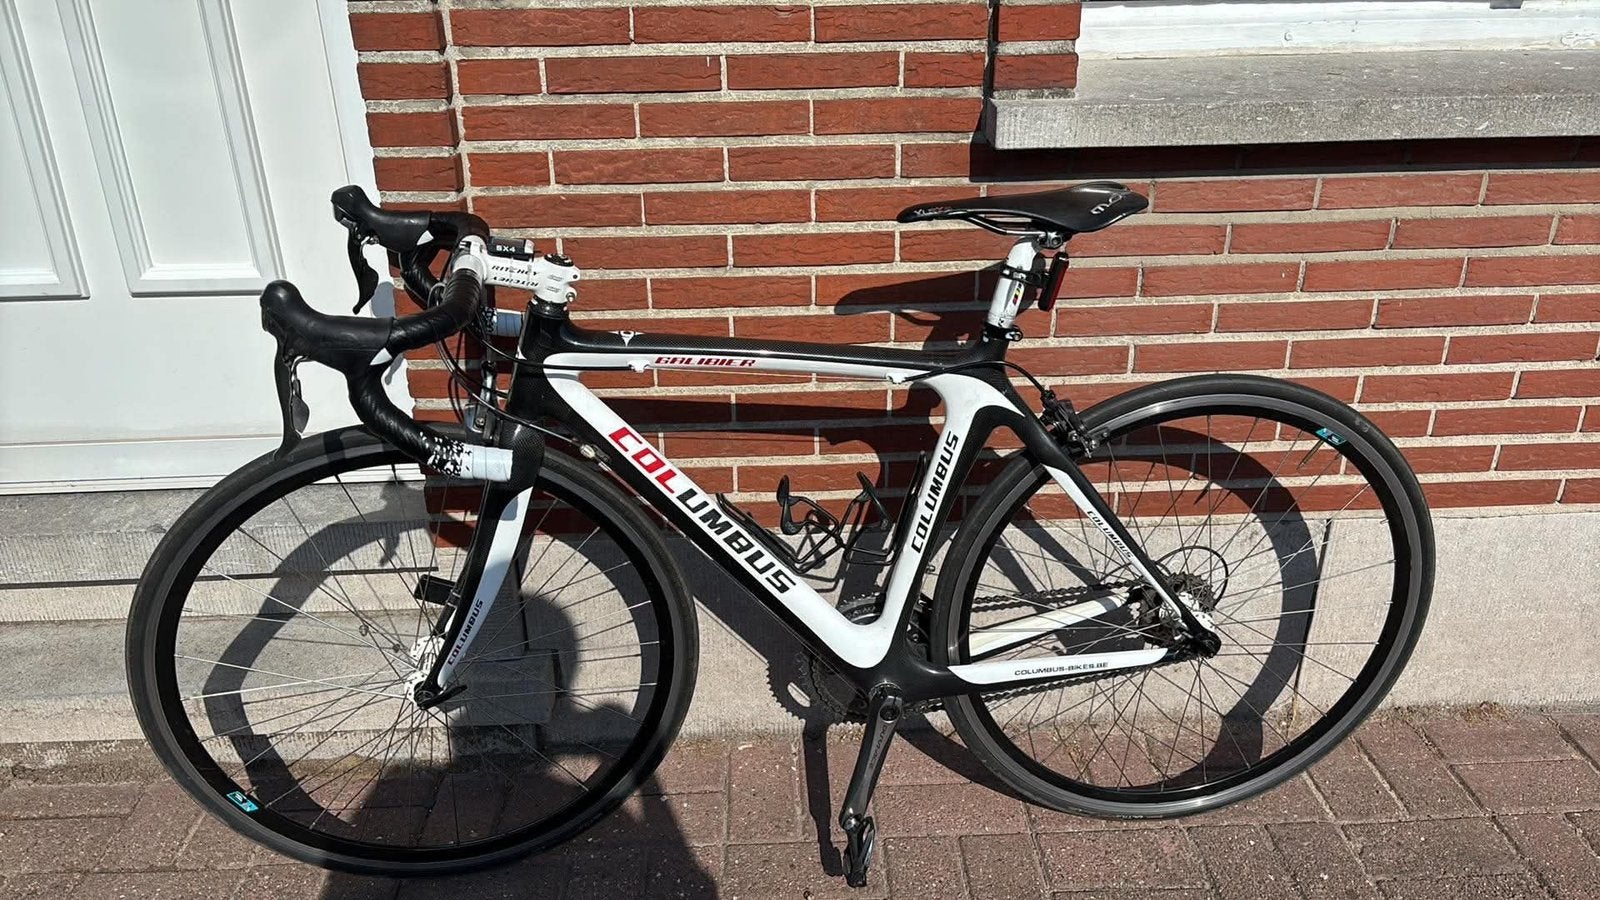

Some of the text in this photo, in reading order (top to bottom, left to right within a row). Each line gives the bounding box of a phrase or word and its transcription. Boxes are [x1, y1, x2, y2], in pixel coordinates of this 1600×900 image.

[654, 356, 756, 367] GALIBIER
[608, 426, 797, 594] COLUMBUS
[911, 430, 959, 554] COLUMBUS
[1086, 510, 1134, 558] COLUMBUS
[447, 598, 484, 666] COLUMBUS
